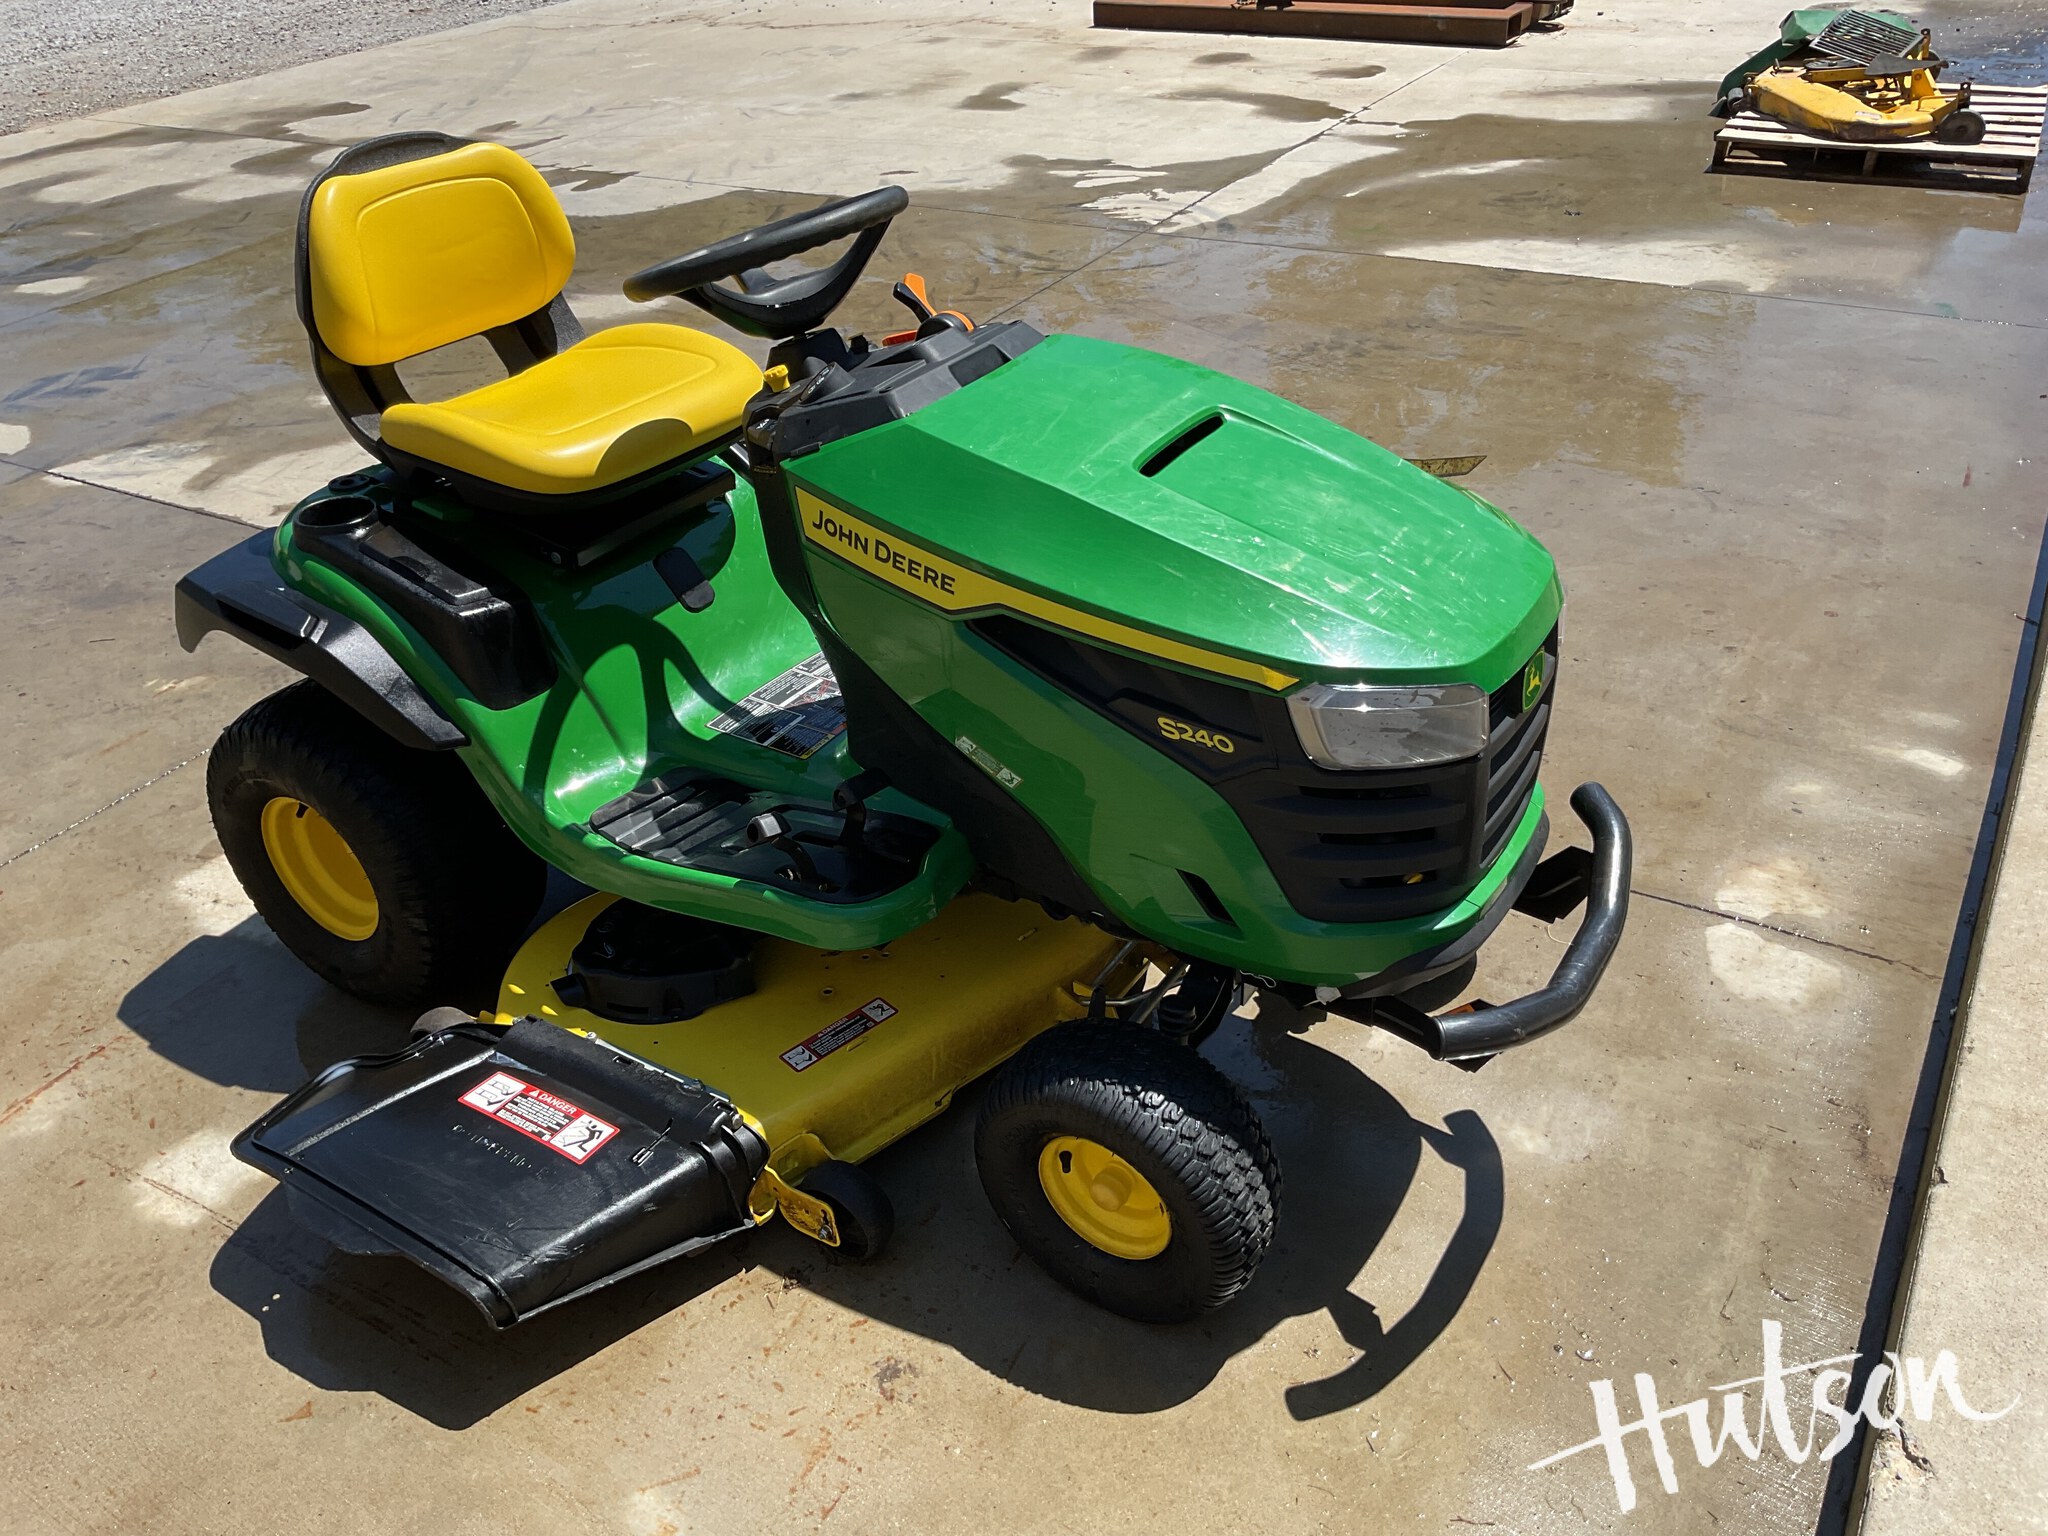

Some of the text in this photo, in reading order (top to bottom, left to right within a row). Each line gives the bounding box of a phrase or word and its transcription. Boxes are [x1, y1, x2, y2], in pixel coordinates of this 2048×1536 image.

[812, 509, 956, 596] JOHN DEERE
[1157, 717, 1234, 753] S240
[538, 1093, 577, 1115] DANGER
